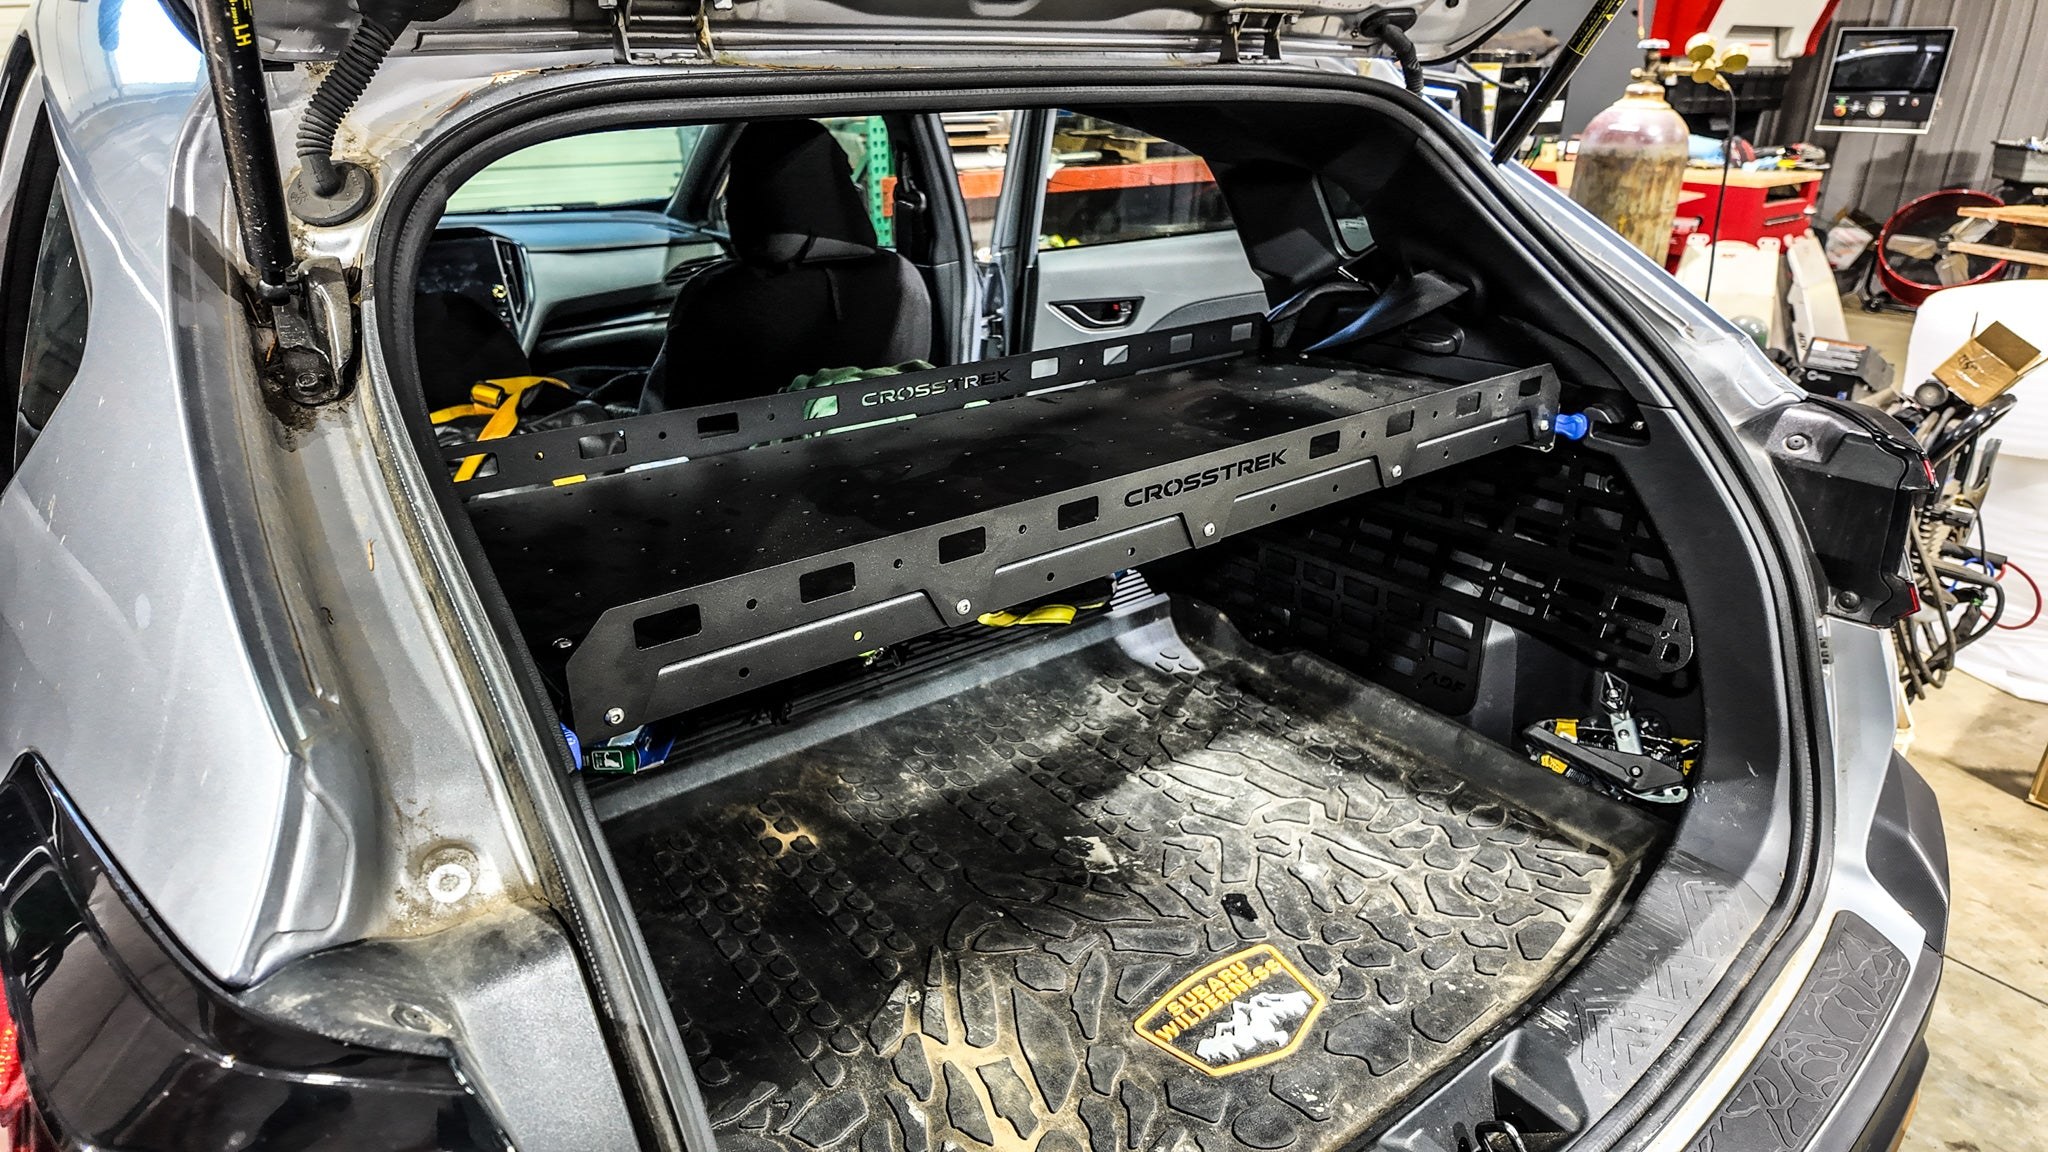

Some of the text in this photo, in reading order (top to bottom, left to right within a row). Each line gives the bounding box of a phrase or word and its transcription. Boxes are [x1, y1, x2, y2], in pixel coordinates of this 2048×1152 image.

[232, 24, 252, 46] LH
[861, 369, 1011, 406] CROSSTREK
[1123, 448, 1288, 507] CROSSTREK
[1154, 959, 1282, 1042] WILDERNESS
[1166, 960, 1249, 1017] SUBARU
